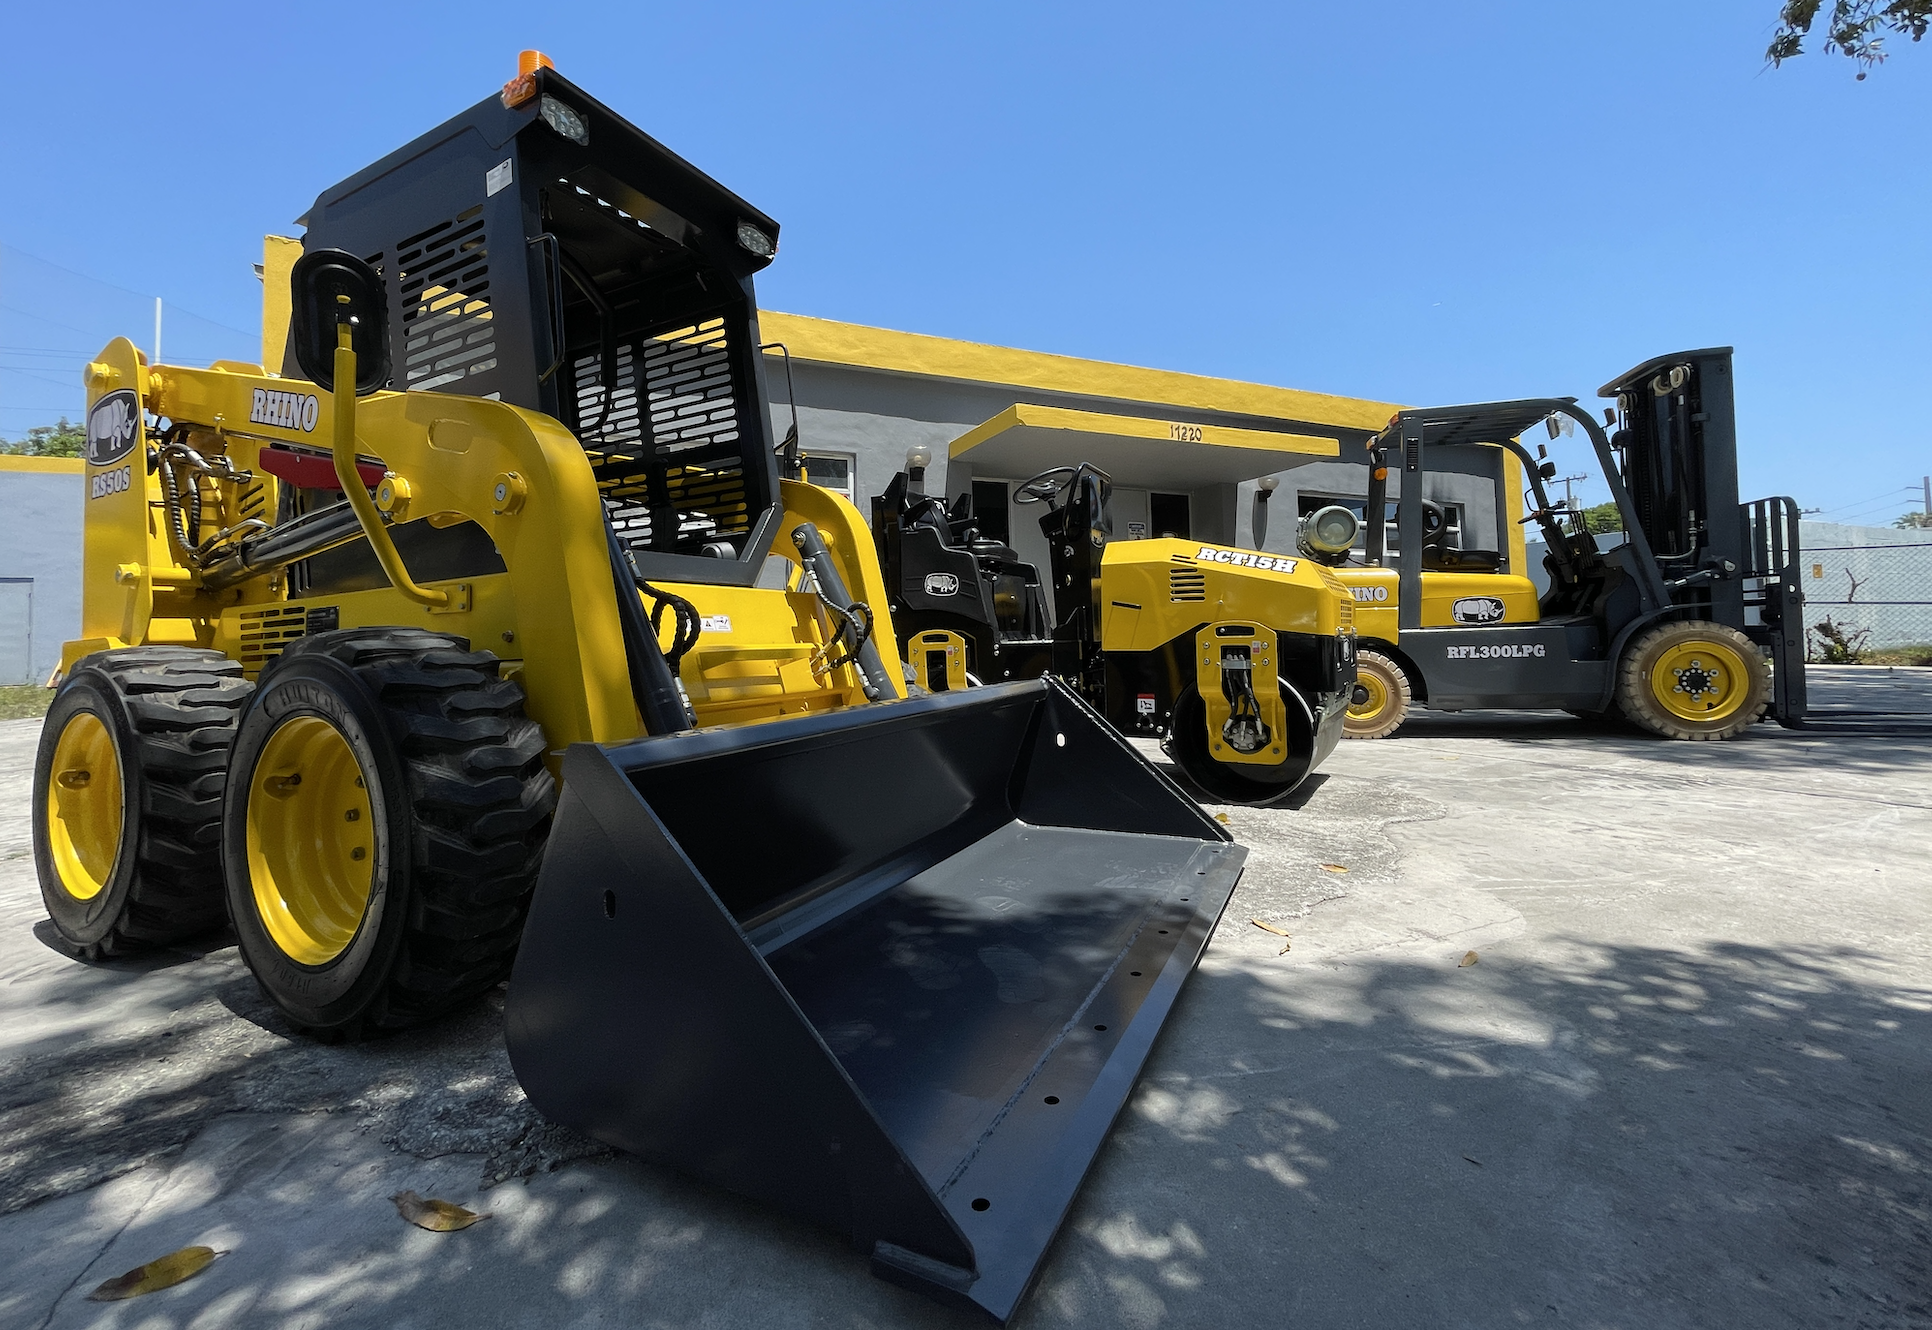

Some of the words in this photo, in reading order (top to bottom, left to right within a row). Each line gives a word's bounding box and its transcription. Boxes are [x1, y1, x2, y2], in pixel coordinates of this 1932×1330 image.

[250, 388, 319, 432] RHINO
[1170, 424, 1202, 442] 11220
[91, 465, 131, 500] RS50S
[1195, 547, 1299, 574] RCT15H
[1348, 586, 1388, 602] INO
[1446, 644, 1546, 659] RFL300LPG
